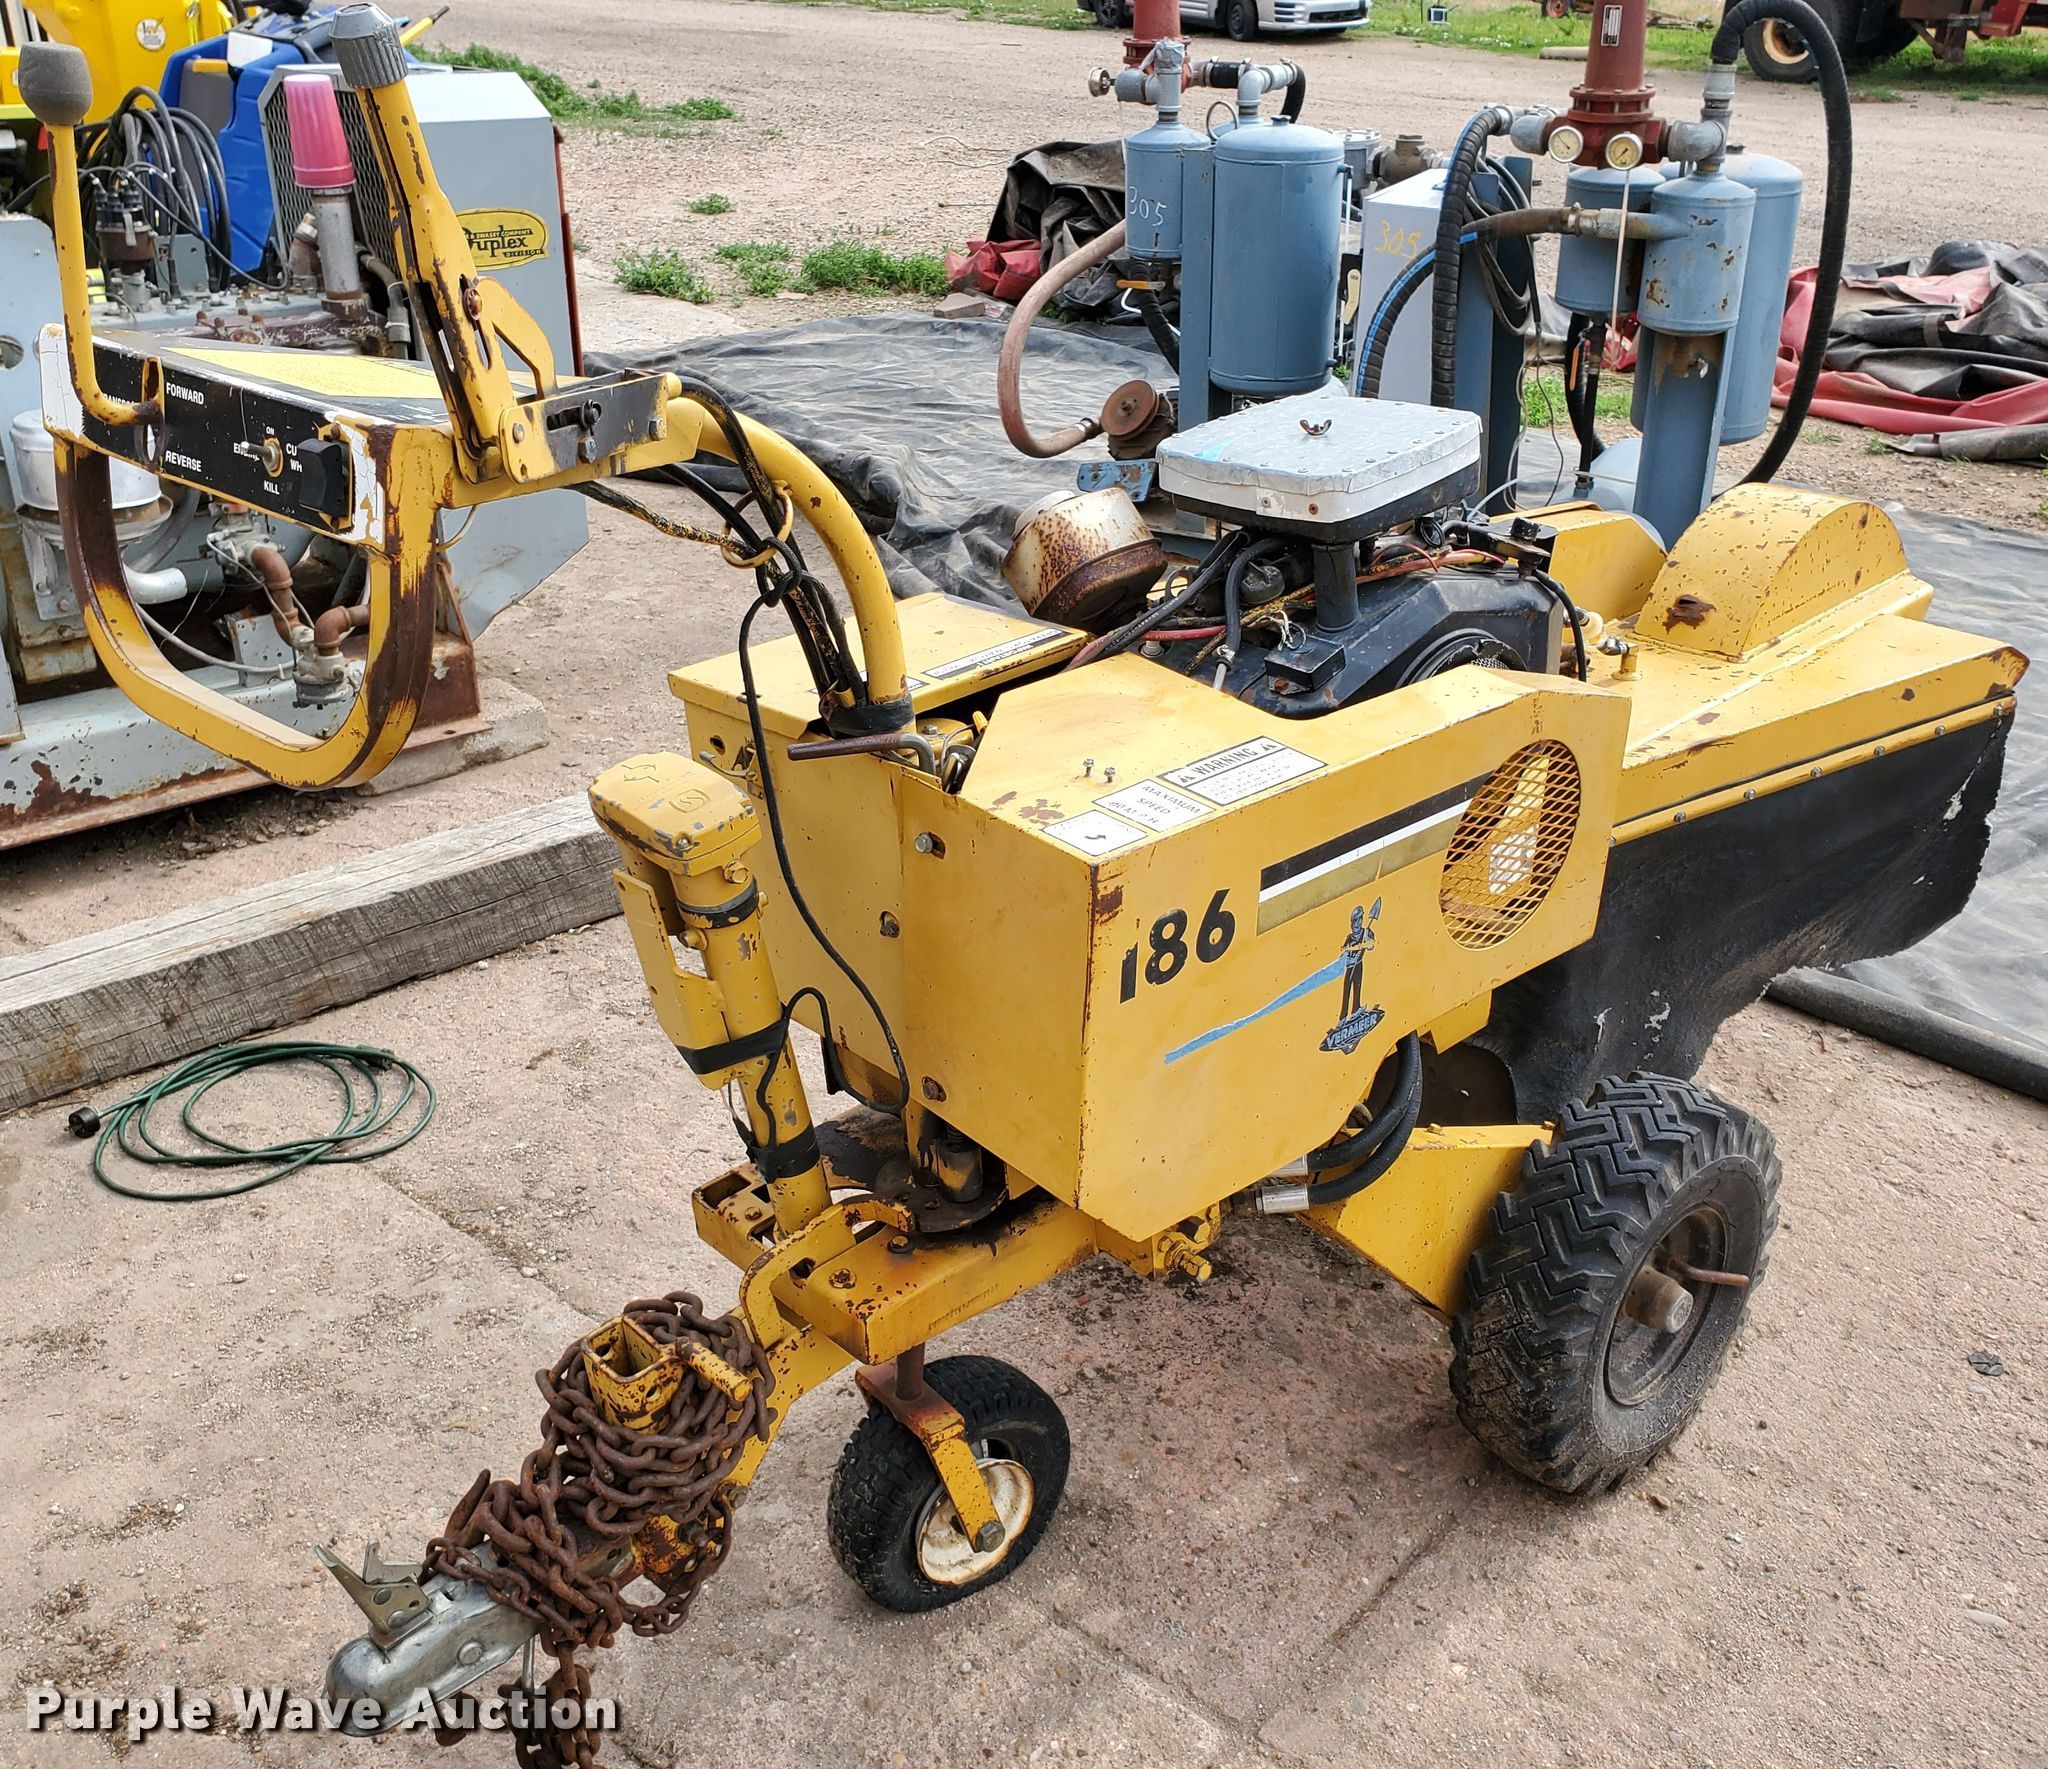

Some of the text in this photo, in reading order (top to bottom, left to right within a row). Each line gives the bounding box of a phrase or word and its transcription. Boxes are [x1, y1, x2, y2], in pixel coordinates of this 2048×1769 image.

[1375, 219, 1423, 261] 305
[166, 382, 204, 405] FORWARD
[265, 426, 275, 436] ON
[165, 450, 202, 472] REVERSE
[263, 480, 280, 495] KILL
[1191, 747, 1259, 776] WARNING
[1136, 797, 1171, 815] SPEED
[1142, 785, 1201, 814] MAXIMUM
[1119, 888, 1236, 1004] 186
[1326, 1013, 1379, 1047] VERMEER
